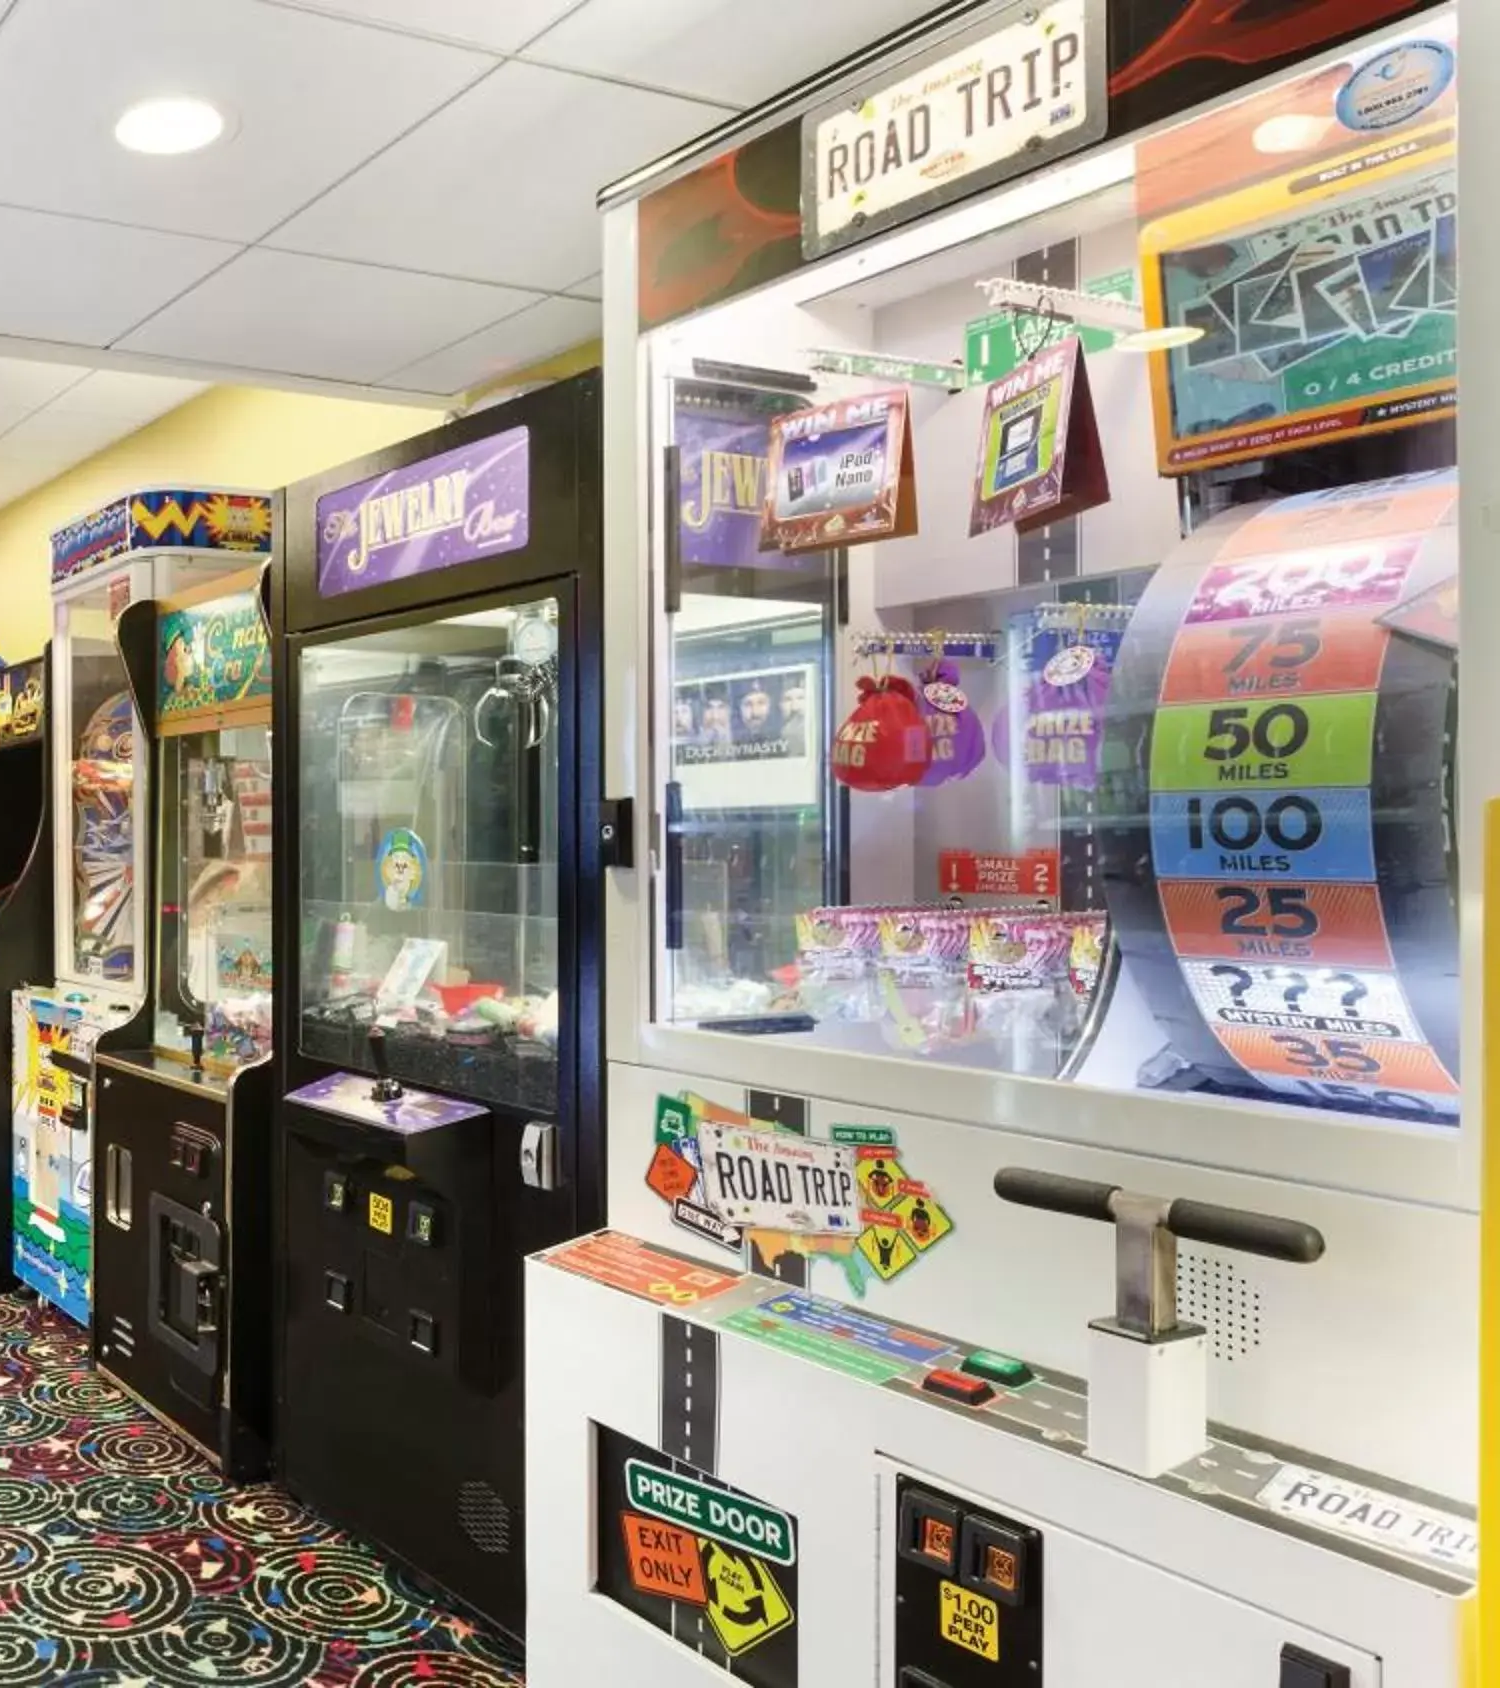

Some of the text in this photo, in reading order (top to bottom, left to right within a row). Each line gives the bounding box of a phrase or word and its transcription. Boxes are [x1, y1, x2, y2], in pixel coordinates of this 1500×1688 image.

[827, 32, 1079, 199] ROAD TRIP
[990, 371, 1028, 408] WIN
[1033, 356, 1065, 383] ME
[1347, 372, 1361, 386] 4
[781, 399, 889, 438] WIN ME
[840, 450, 873, 469] iPod
[835, 468, 873, 488] Nano
[348, 468, 469, 574] JEWELRY
[463, 500, 521, 543] Box
[1214, 552, 1388, 605] 200
[1252, 594, 1327, 616] MILES
[1222, 619, 1323, 674] 75
[1228, 671, 1300, 693] MILES
[1203, 703, 1309, 761] 50
[724, 738, 790, 757] DYNASTY
[1218, 763, 1290, 782] MILES
[1187, 794, 1323, 851] 100
[1033, 863, 1049, 882] 2
[1219, 854, 1292, 872] MILES
[1215, 886, 1319, 938] 25
[1237, 939, 1311, 958] MILES
[1223, 1008, 1394, 1036] MYSTERY MILES
[1271, 1034, 1381, 1073] 35
[745, 1134, 770, 1153] The
[715, 1152, 793, 1205] ROAD
[796, 1165, 852, 1208] TRIP
[636, 1475, 784, 1550] PRIZE DOOR
[1283, 1481, 1402, 1531] ROAD
[638, 1526, 683, 1555] EXIT
[639, 1557, 693, 1586] ONLY
[943, 1587, 995, 1627] $1.00
[947, 1623, 990, 1653] PLAY
[953, 1613, 985, 1639] PER
